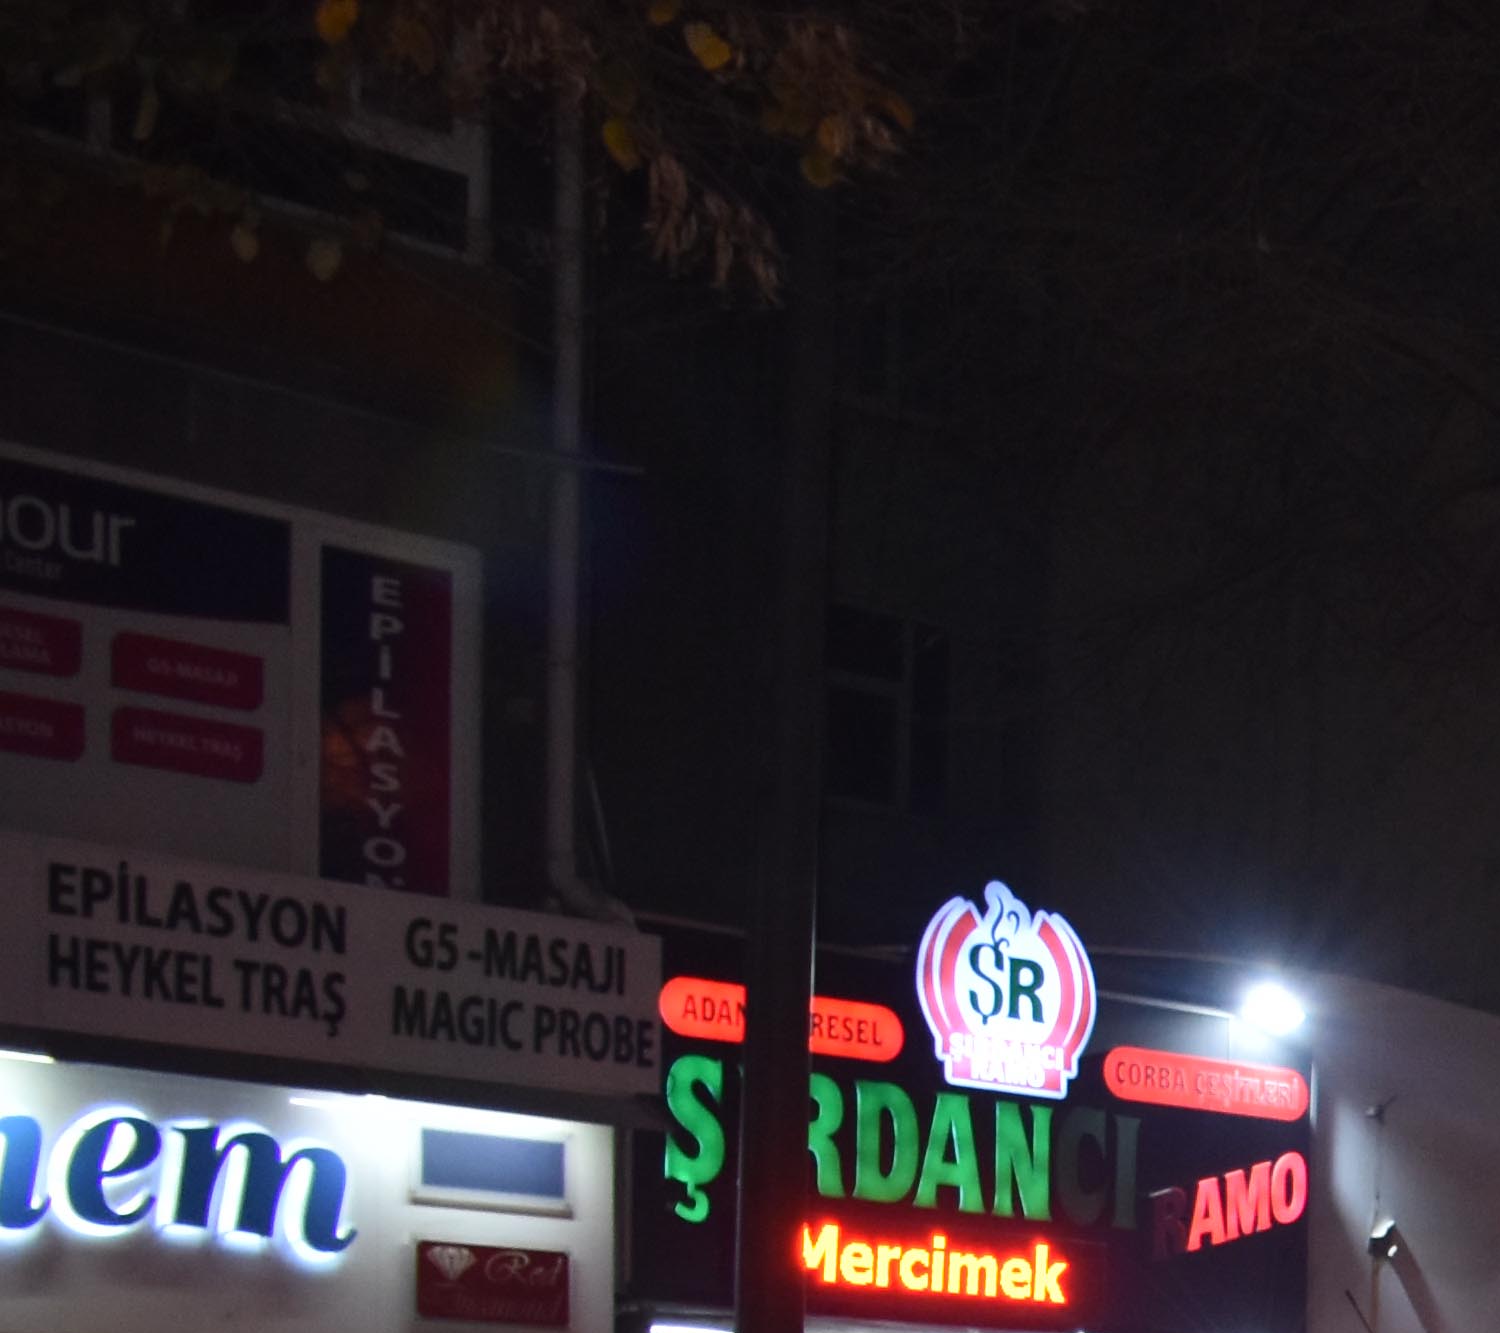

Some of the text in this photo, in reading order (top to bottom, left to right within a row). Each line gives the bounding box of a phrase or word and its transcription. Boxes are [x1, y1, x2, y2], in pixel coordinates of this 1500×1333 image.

[0, 496, 136, 567] our
[48, 861, 347, 956] EPİLASYON
[49, 934, 347, 1036] HEYKEL TRAŞ
[393, 985, 655, 1069] MAGIC PROBE
[801, 1224, 1068, 1304] Mercimek
